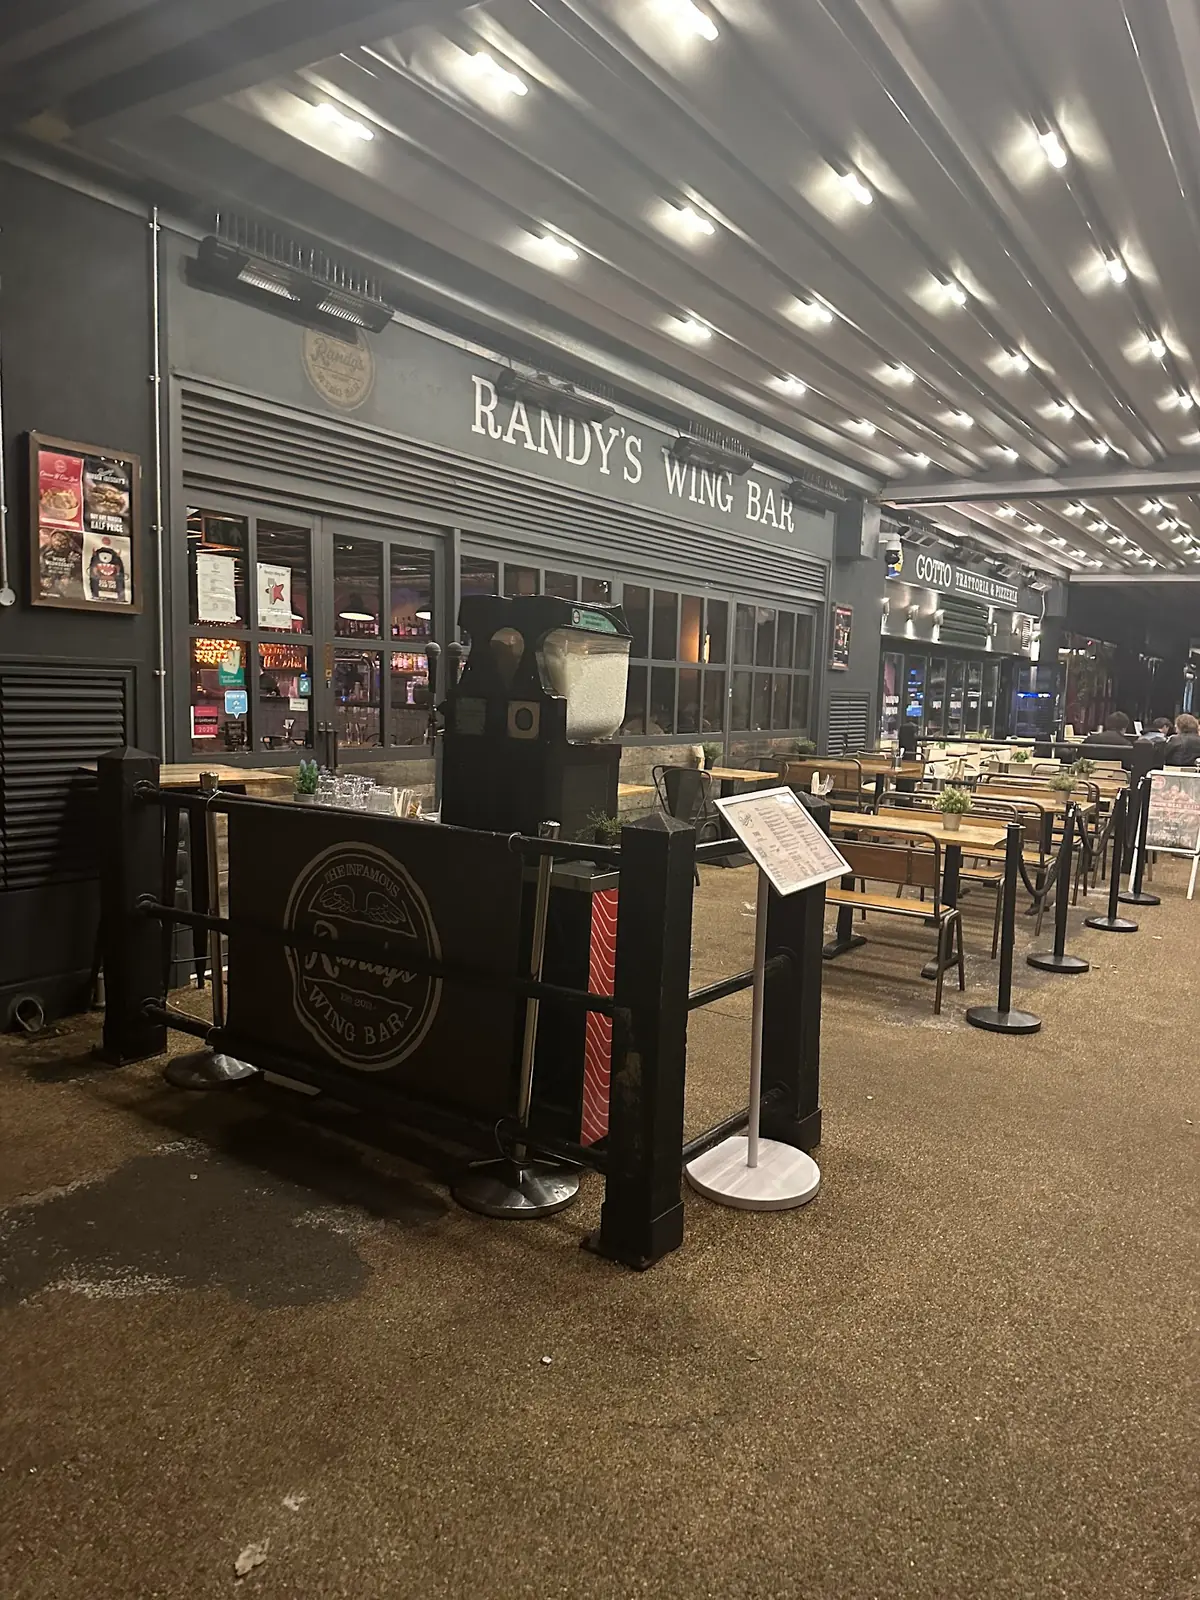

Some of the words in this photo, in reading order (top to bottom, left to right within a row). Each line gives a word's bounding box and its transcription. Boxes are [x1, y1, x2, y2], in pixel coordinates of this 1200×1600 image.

[317, 370, 343, 397] WING
[344, 382, 361, 398] BAR
[471, 374, 643, 485] RANDY'S
[661, 447, 734, 513] WING
[745, 479, 795, 534] BAR
[90, 520, 106, 530] HALF
[106, 522, 124, 533] PRICE
[916, 554, 952, 588] GOTTO
[955, 571, 989, 595] TRATTORIA
[990, 583, 995, 596] &
[995, 584, 1018, 603] PIZZERIA
[324, 864, 346, 884] THE
[346, 863, 401, 898] INFAMOUS
[308, 984, 356, 1044] WING
[363, 1011, 405, 1045] BAR
